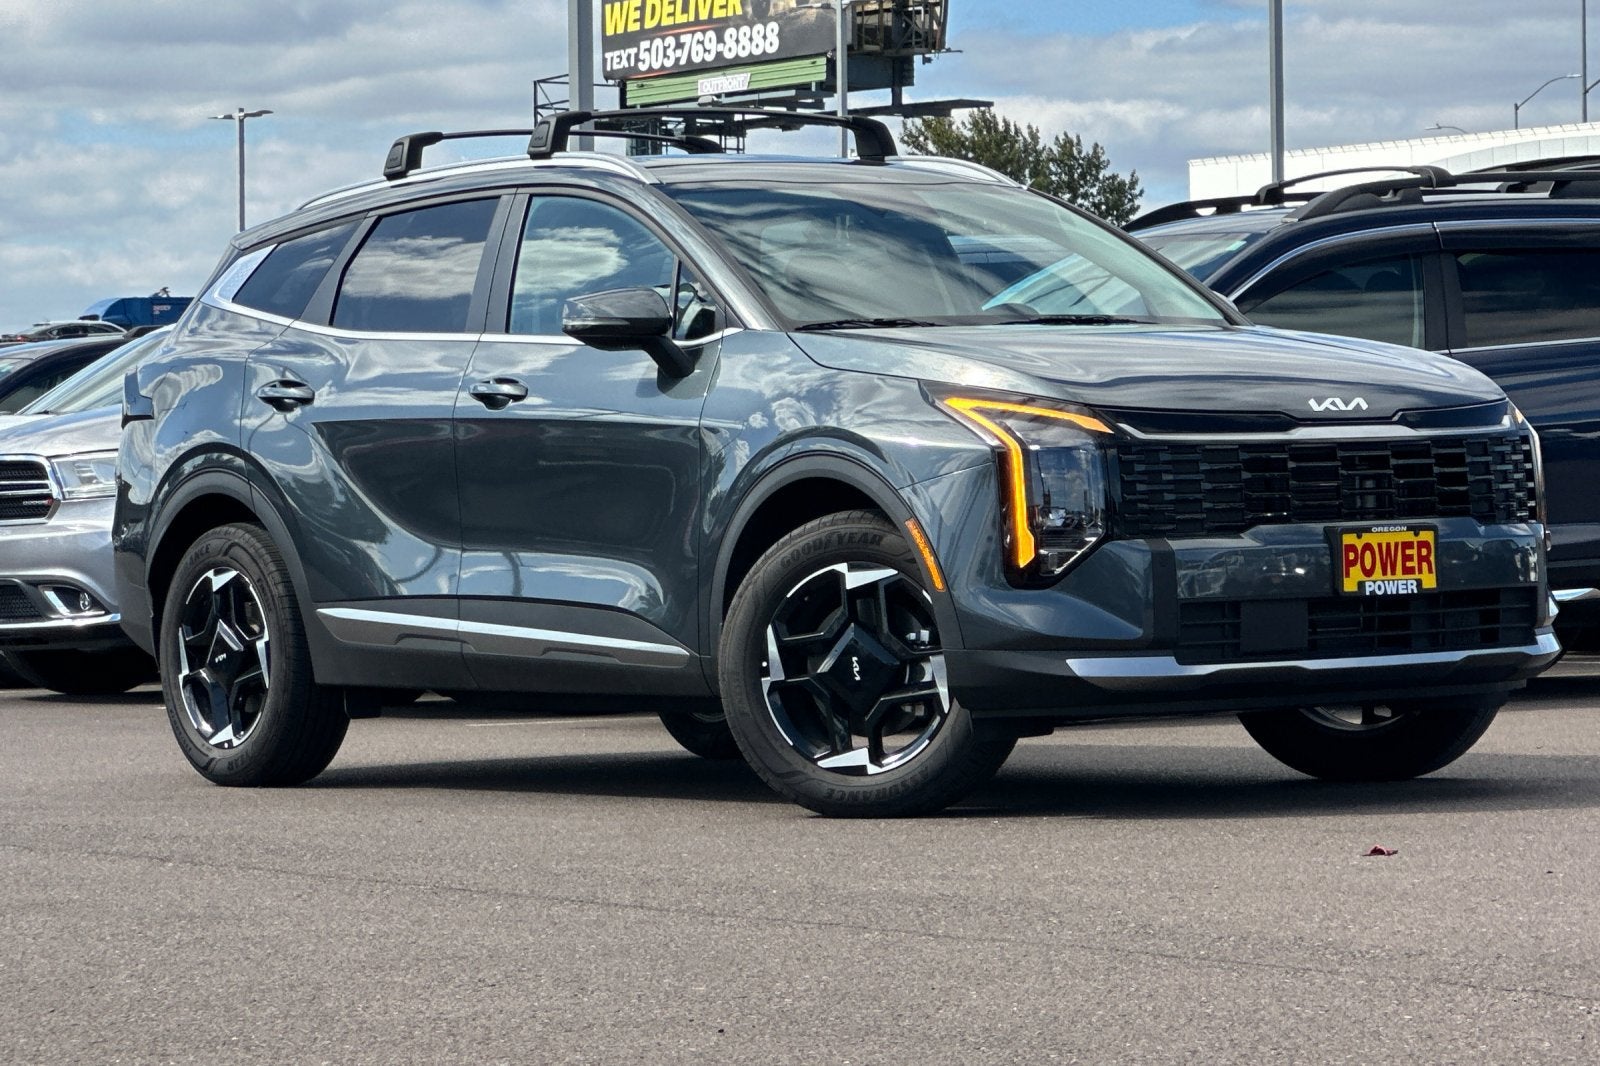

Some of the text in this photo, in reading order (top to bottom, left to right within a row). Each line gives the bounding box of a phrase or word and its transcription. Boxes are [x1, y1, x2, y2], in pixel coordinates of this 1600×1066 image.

[604, 0, 743, 36] WE DELIVER
[604, 21, 780, 71] TEXT 503-769-8888
[702, 77, 746, 93] OUTFRONT
[1308, 397, 1369, 412] KIA
[1371, 525, 1407, 533] OREGON
[1344, 540, 1433, 578] POWER
[1365, 580, 1418, 595] POWER
